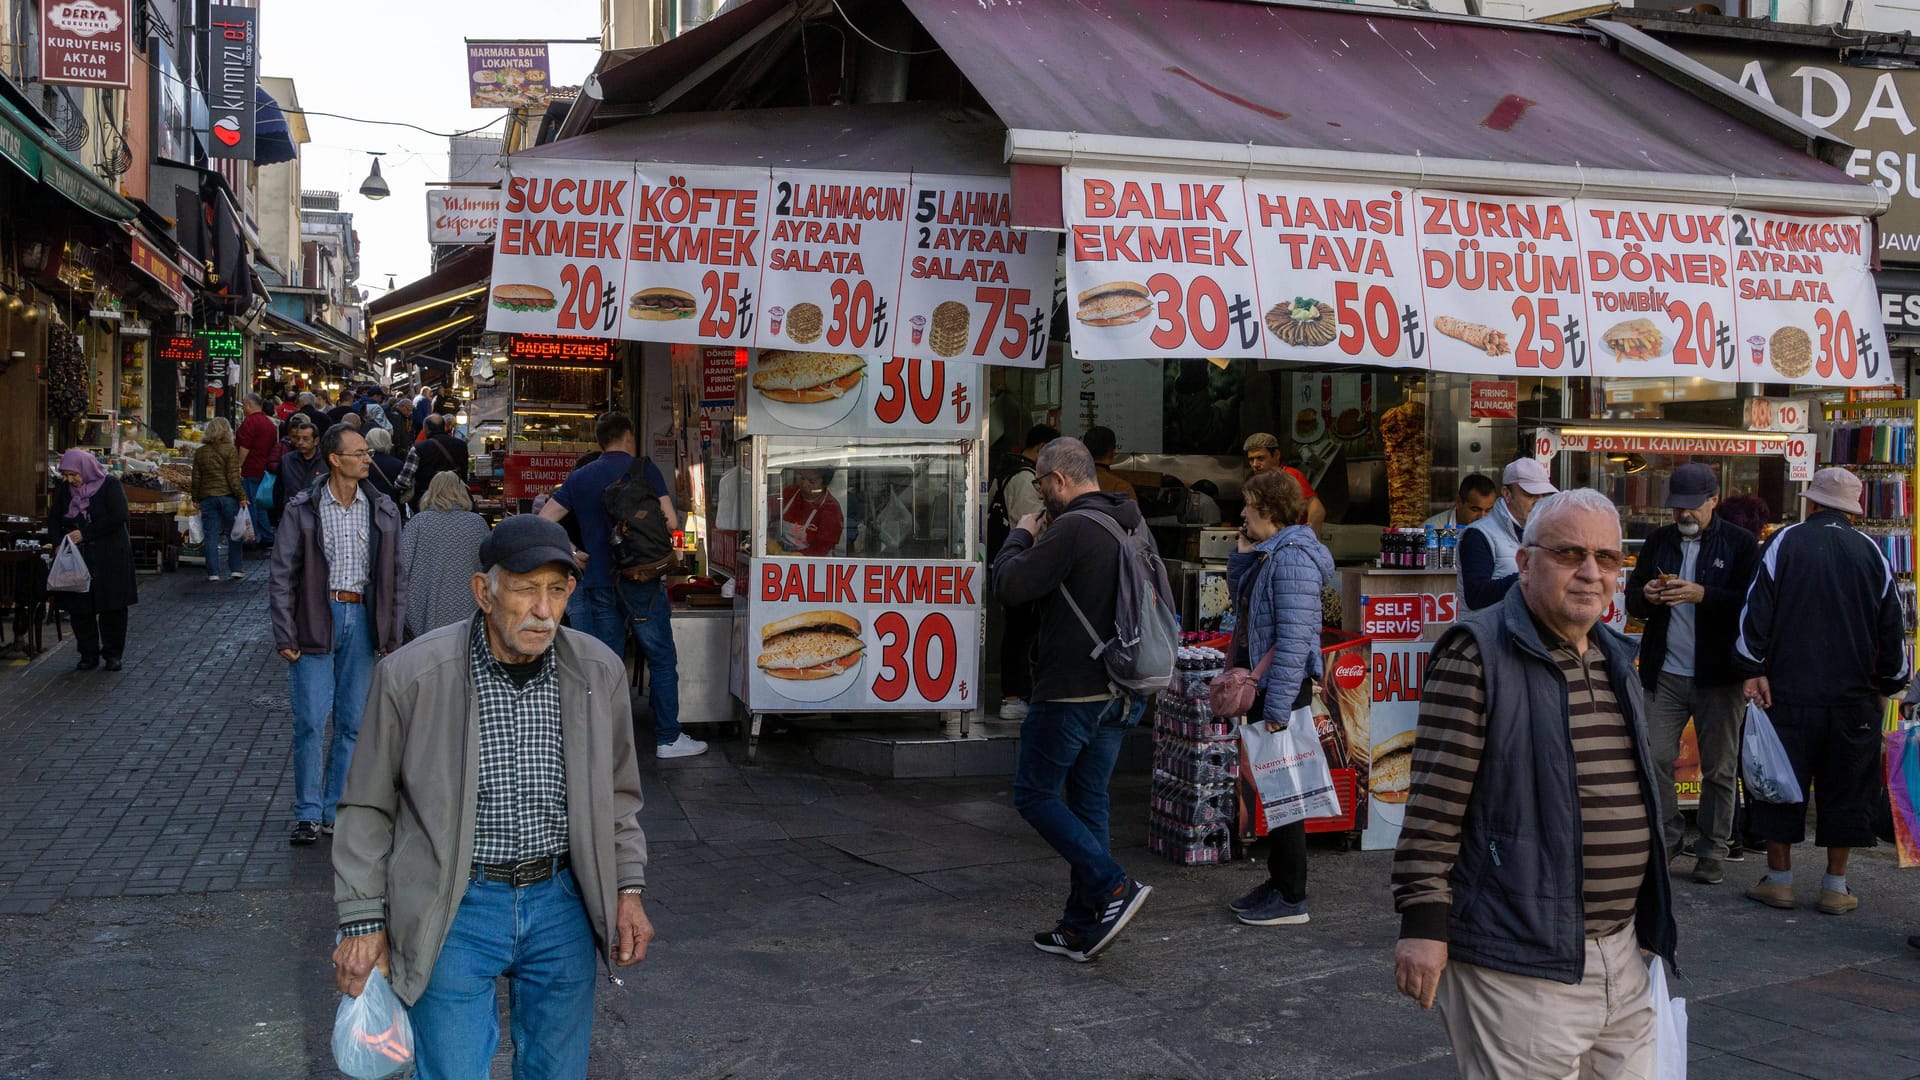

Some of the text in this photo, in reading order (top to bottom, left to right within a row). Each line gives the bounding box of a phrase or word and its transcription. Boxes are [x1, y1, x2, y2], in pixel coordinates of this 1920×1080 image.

[62, 8, 107, 20] DERYA
[63, 52, 106, 65] AKTAR
[470, 48, 545, 57] MARMARA BALIK
[482, 59, 533, 68] LOKANTASI
[63, 66, 107, 79] LOKUM
[505, 177, 628, 217] SUCUK
[639, 176, 758, 227] KÖFTE
[792, 184, 905, 221] LAHMACUN
[1083, 179, 1228, 222] BALIK
[1257, 190, 1404, 237] HAMSİ
[1421, 197, 1570, 241] ZURNA
[1589, 208, 1726, 247] TAVUK
[500, 219, 625, 260] EKMEK
[630, 224, 760, 266] EKMEK
[771, 220, 861, 246] AYRAN
[918, 227, 1028, 255] 2 AYRAN
[1072, 225, 1248, 267] EKMEK
[1750, 217, 1863, 257] LAHMACUN
[769, 248, 865, 275] SALATA
[910, 255, 1010, 284] SALATA
[1279, 233, 1394, 278] TAVA
[1424, 238, 1580, 296] DÜRÜM
[1588, 243, 1728, 289] DÖNER
[1736, 249, 1824, 276] AYRAN
[1591, 286, 1670, 314] TOMBİK
[1738, 278, 1834, 305] SALATA
[516, 342, 560, 355] BADEM
[1473, 401, 1514, 410] ALINACAK
[1479, 388, 1508, 397] FIRINCI
[1561, 435, 1584, 449] ŞOK
[1593, 437, 1618, 450] 30.
[1623, 437, 1645, 450] YIL
[1649, 438, 1750, 453] KAMPANYASI
[521, 471, 557, 480] HELVAMIZI
[530, 458, 564, 467] BALIKTAN
[762, 563, 976, 605] BALIK EKMEK
[1374, 603, 1413, 616] SELF
[1366, 617, 1421, 634] SERVİS
